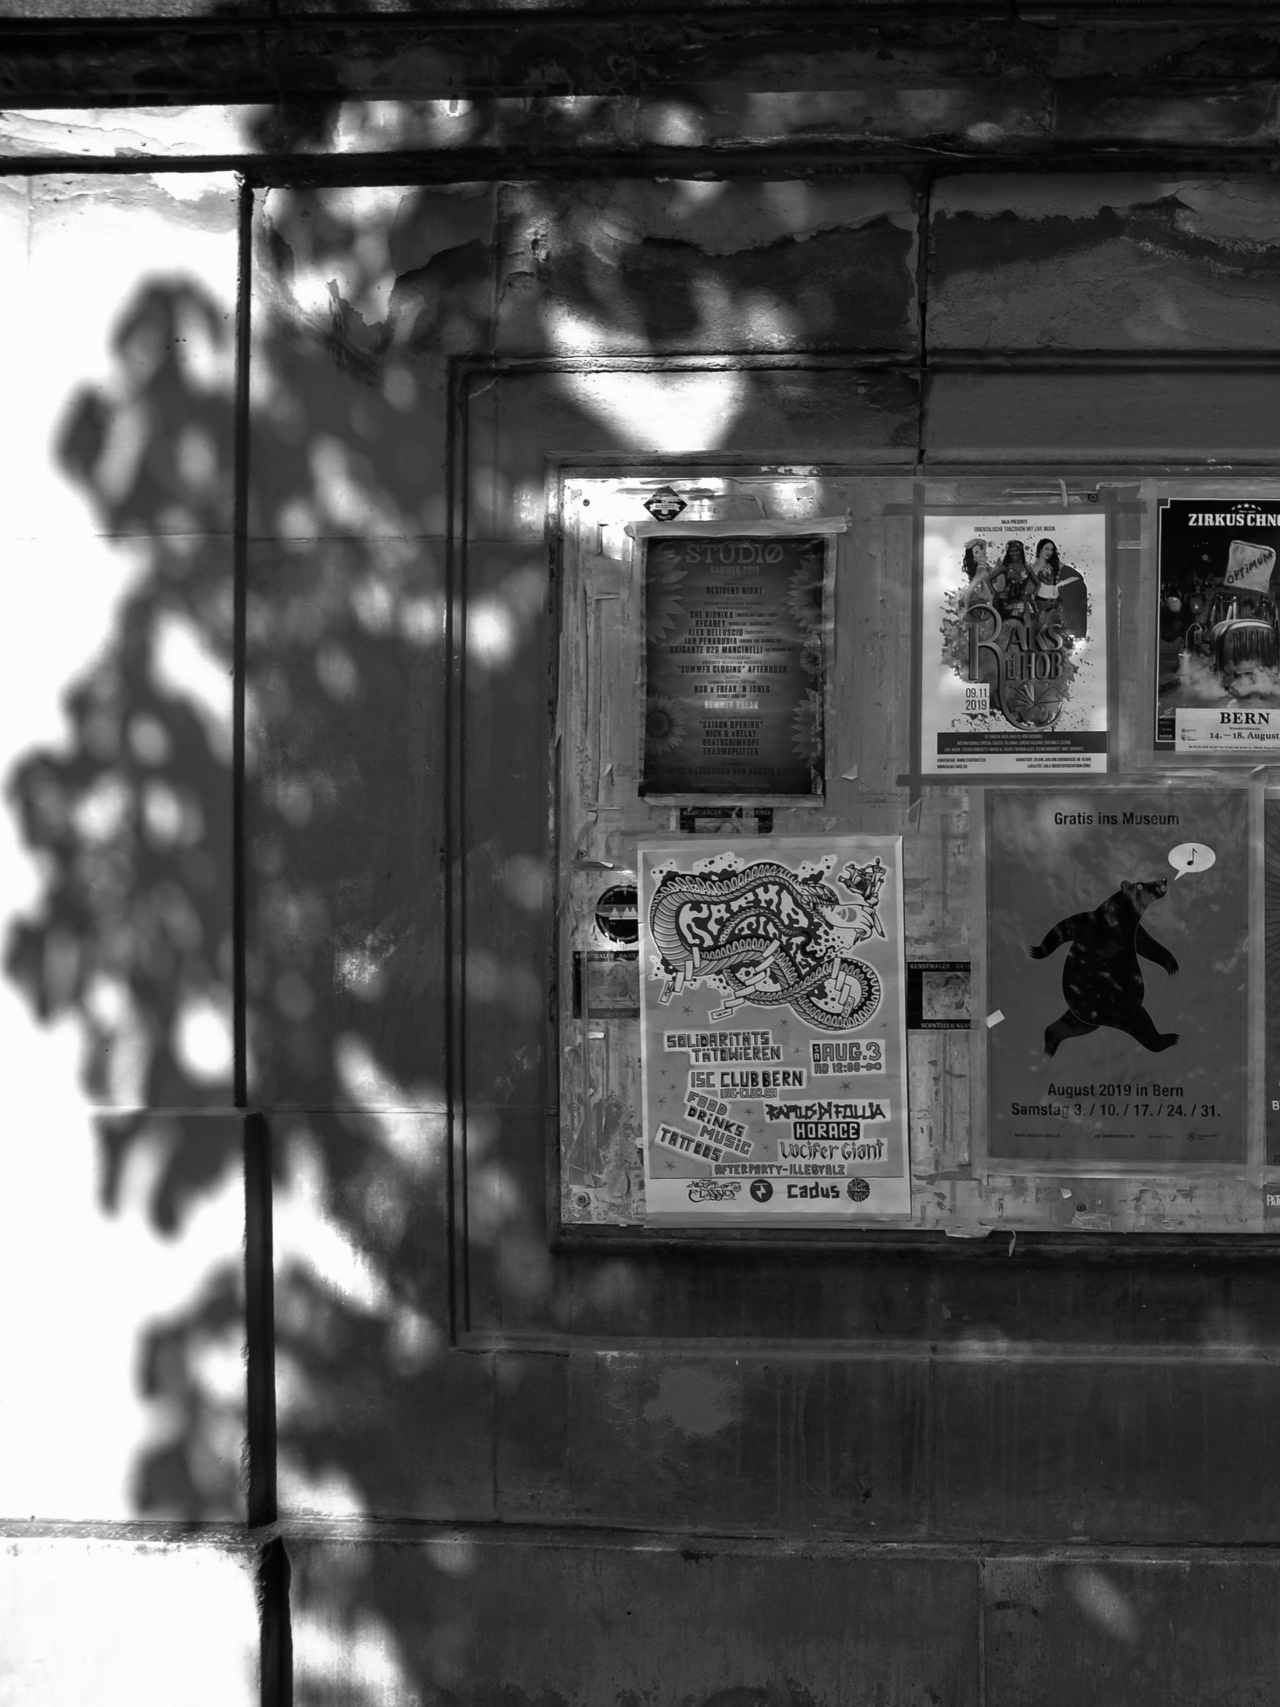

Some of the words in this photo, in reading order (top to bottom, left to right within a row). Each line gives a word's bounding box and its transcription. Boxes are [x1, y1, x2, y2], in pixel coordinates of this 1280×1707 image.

[1188, 513, 1245, 526] ZIRKUS
[706, 587, 739, 595] RESIDENT
[742, 587, 762, 595] NIGHT
[966, 688, 989, 698] 09.11.
[966, 700, 987, 710] 2019
[1220, 712, 1270, 724] BERN
[1247, 732, 1279, 740] August
[1054, 812, 1093, 825] Gratis
[1098, 812, 1117, 825] ins
[1123, 812, 1179, 825] Museum
[691, 1072, 715, 1088] ISC
[721, 1071, 759, 1087] CLUB
[762, 1071, 802, 1087] BERN
[1048, 1084, 1095, 1098] August
[1099, 1084, 1131, 1097] 2019
[1136, 1084, 1147, 1097] in
[1153, 1084, 1183, 1097] Bern
[687, 1091, 728, 1115] FOOD
[1011, 1103, 1069, 1119] Samstag
[796, 1123, 858, 1138] HORACE
[660, 1127, 723, 1162] TATTOOS
[780, 1141, 839, 1160] Lucifer
[841, 1139, 884, 1160] Giant
